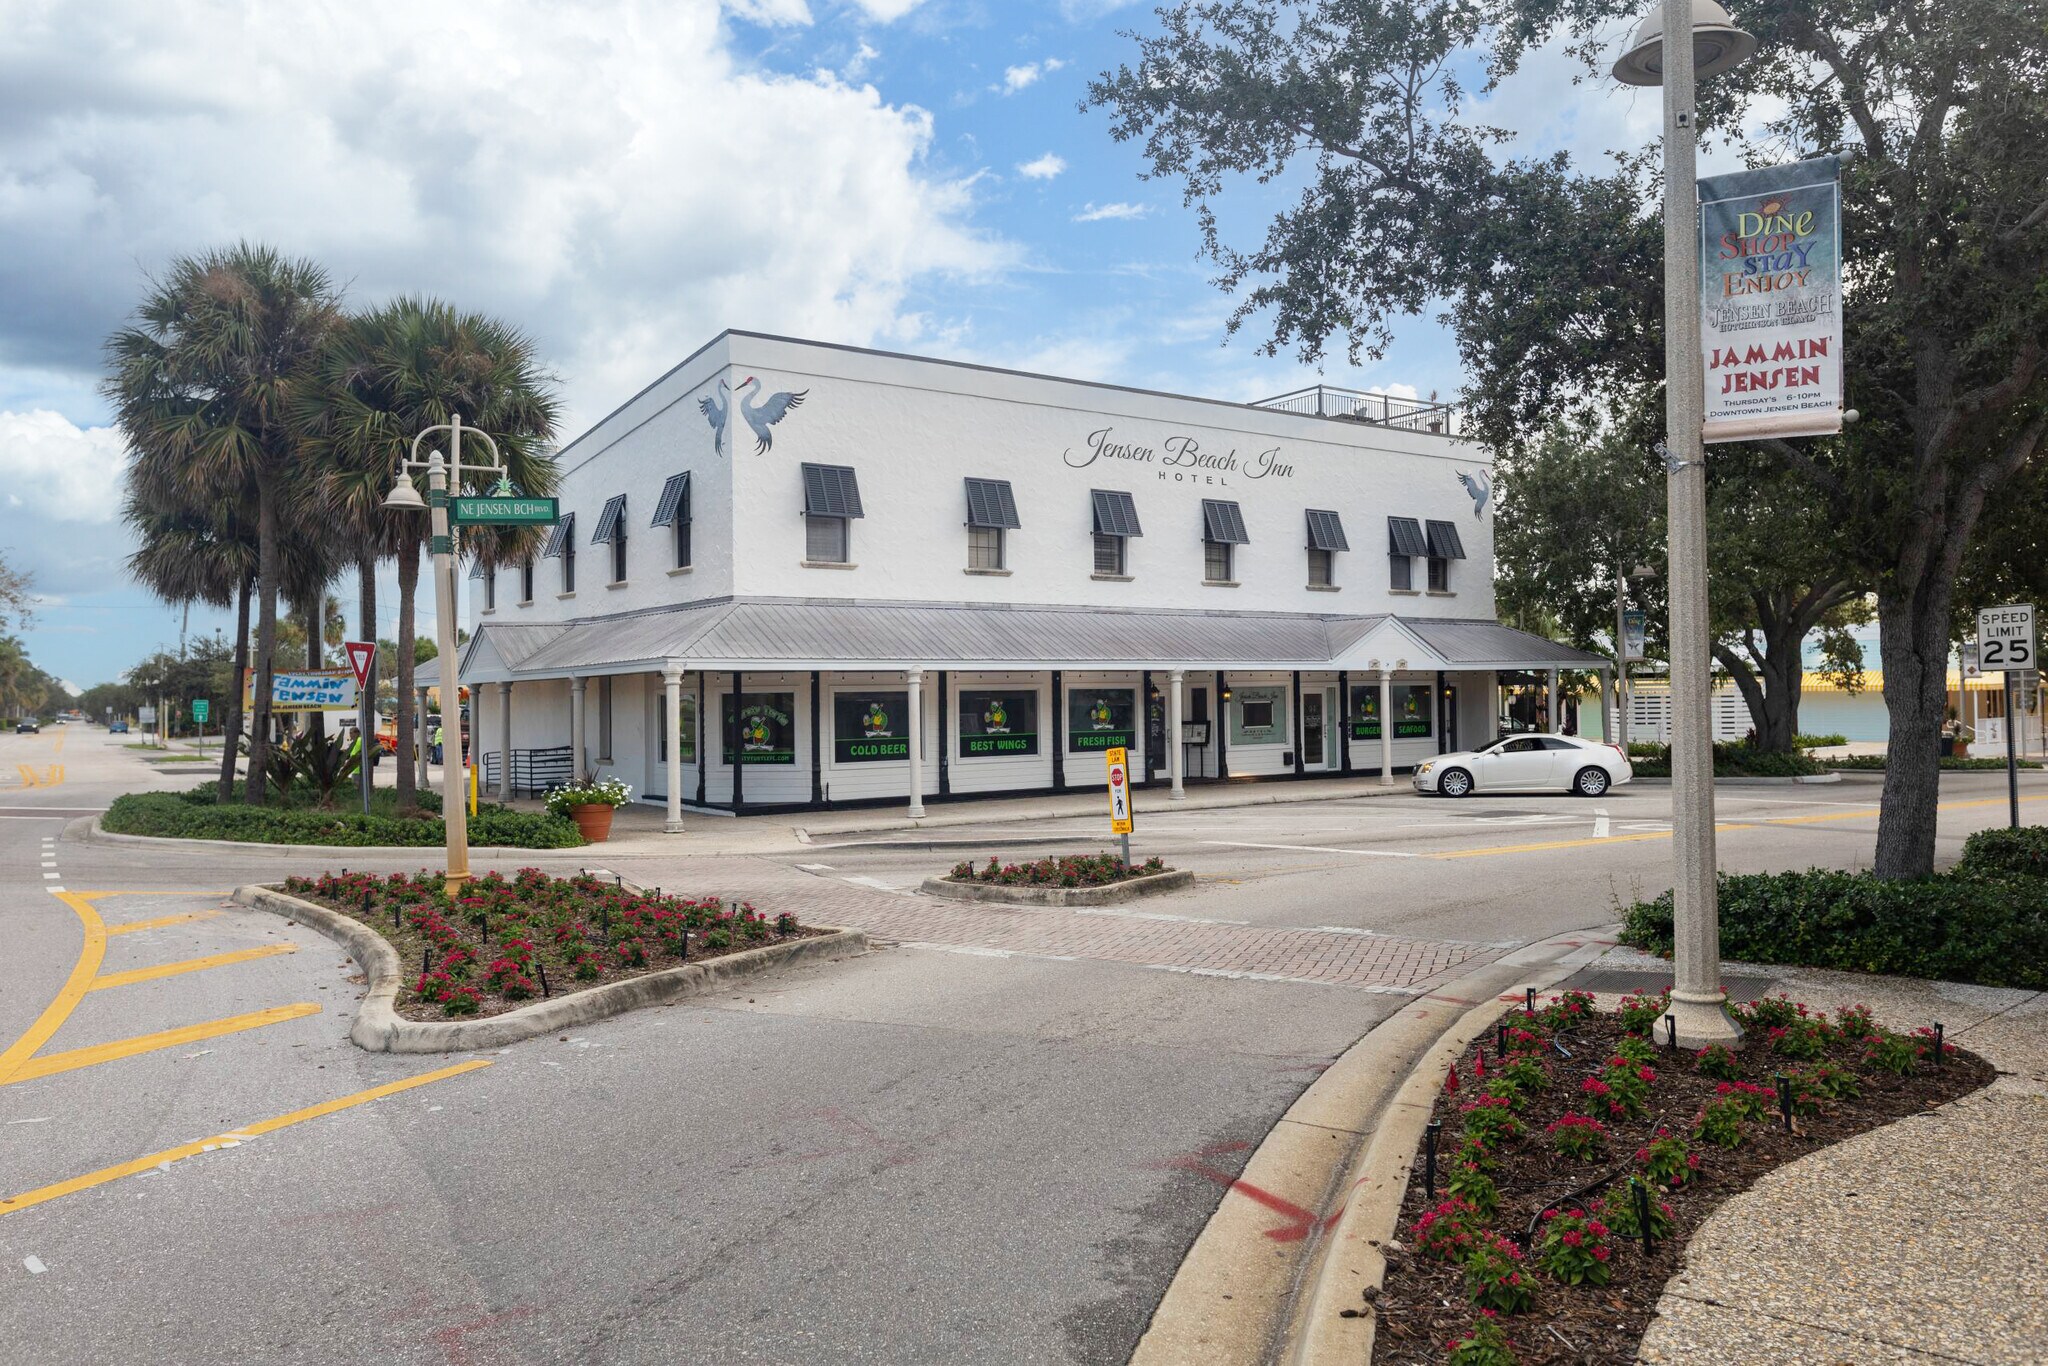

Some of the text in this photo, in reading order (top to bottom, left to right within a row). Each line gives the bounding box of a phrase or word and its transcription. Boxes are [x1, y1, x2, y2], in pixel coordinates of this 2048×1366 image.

[1718, 232, 1796, 260] SHOP
[1722, 269, 1812, 299] ENJOY
[1711, 294, 1833, 328] JENSEN BEACH
[1780, 314, 1816, 326] ISLAND
[1710, 335, 1833, 370] JAMMIN'
[1721, 365, 1820, 395] JENSEN
[1724, 392, 1821, 407] THURSDAY'S 6-10PM
[1710, 400, 1832, 417] DOWNTOWN JENSEN BEACH
[1063, 426, 1295, 479] Jensen Beach Inn
[1158, 471, 1228, 486] HOTEL
[461, 503, 474, 515] NE
[476, 503, 511, 517] JENSEN
[514, 503, 534, 515] BCH
[1982, 612, 2029, 625] SPEED
[1987, 626, 2023, 638] LIMIT
[1983, 639, 2029, 664] 25
[1398, 725, 1427, 734] SEAFOOD
[970, 739, 1027, 751] BEST WINGS
[1078, 736, 1126, 747] FRESH FISH
[850, 744, 907, 756] COLD BEER
